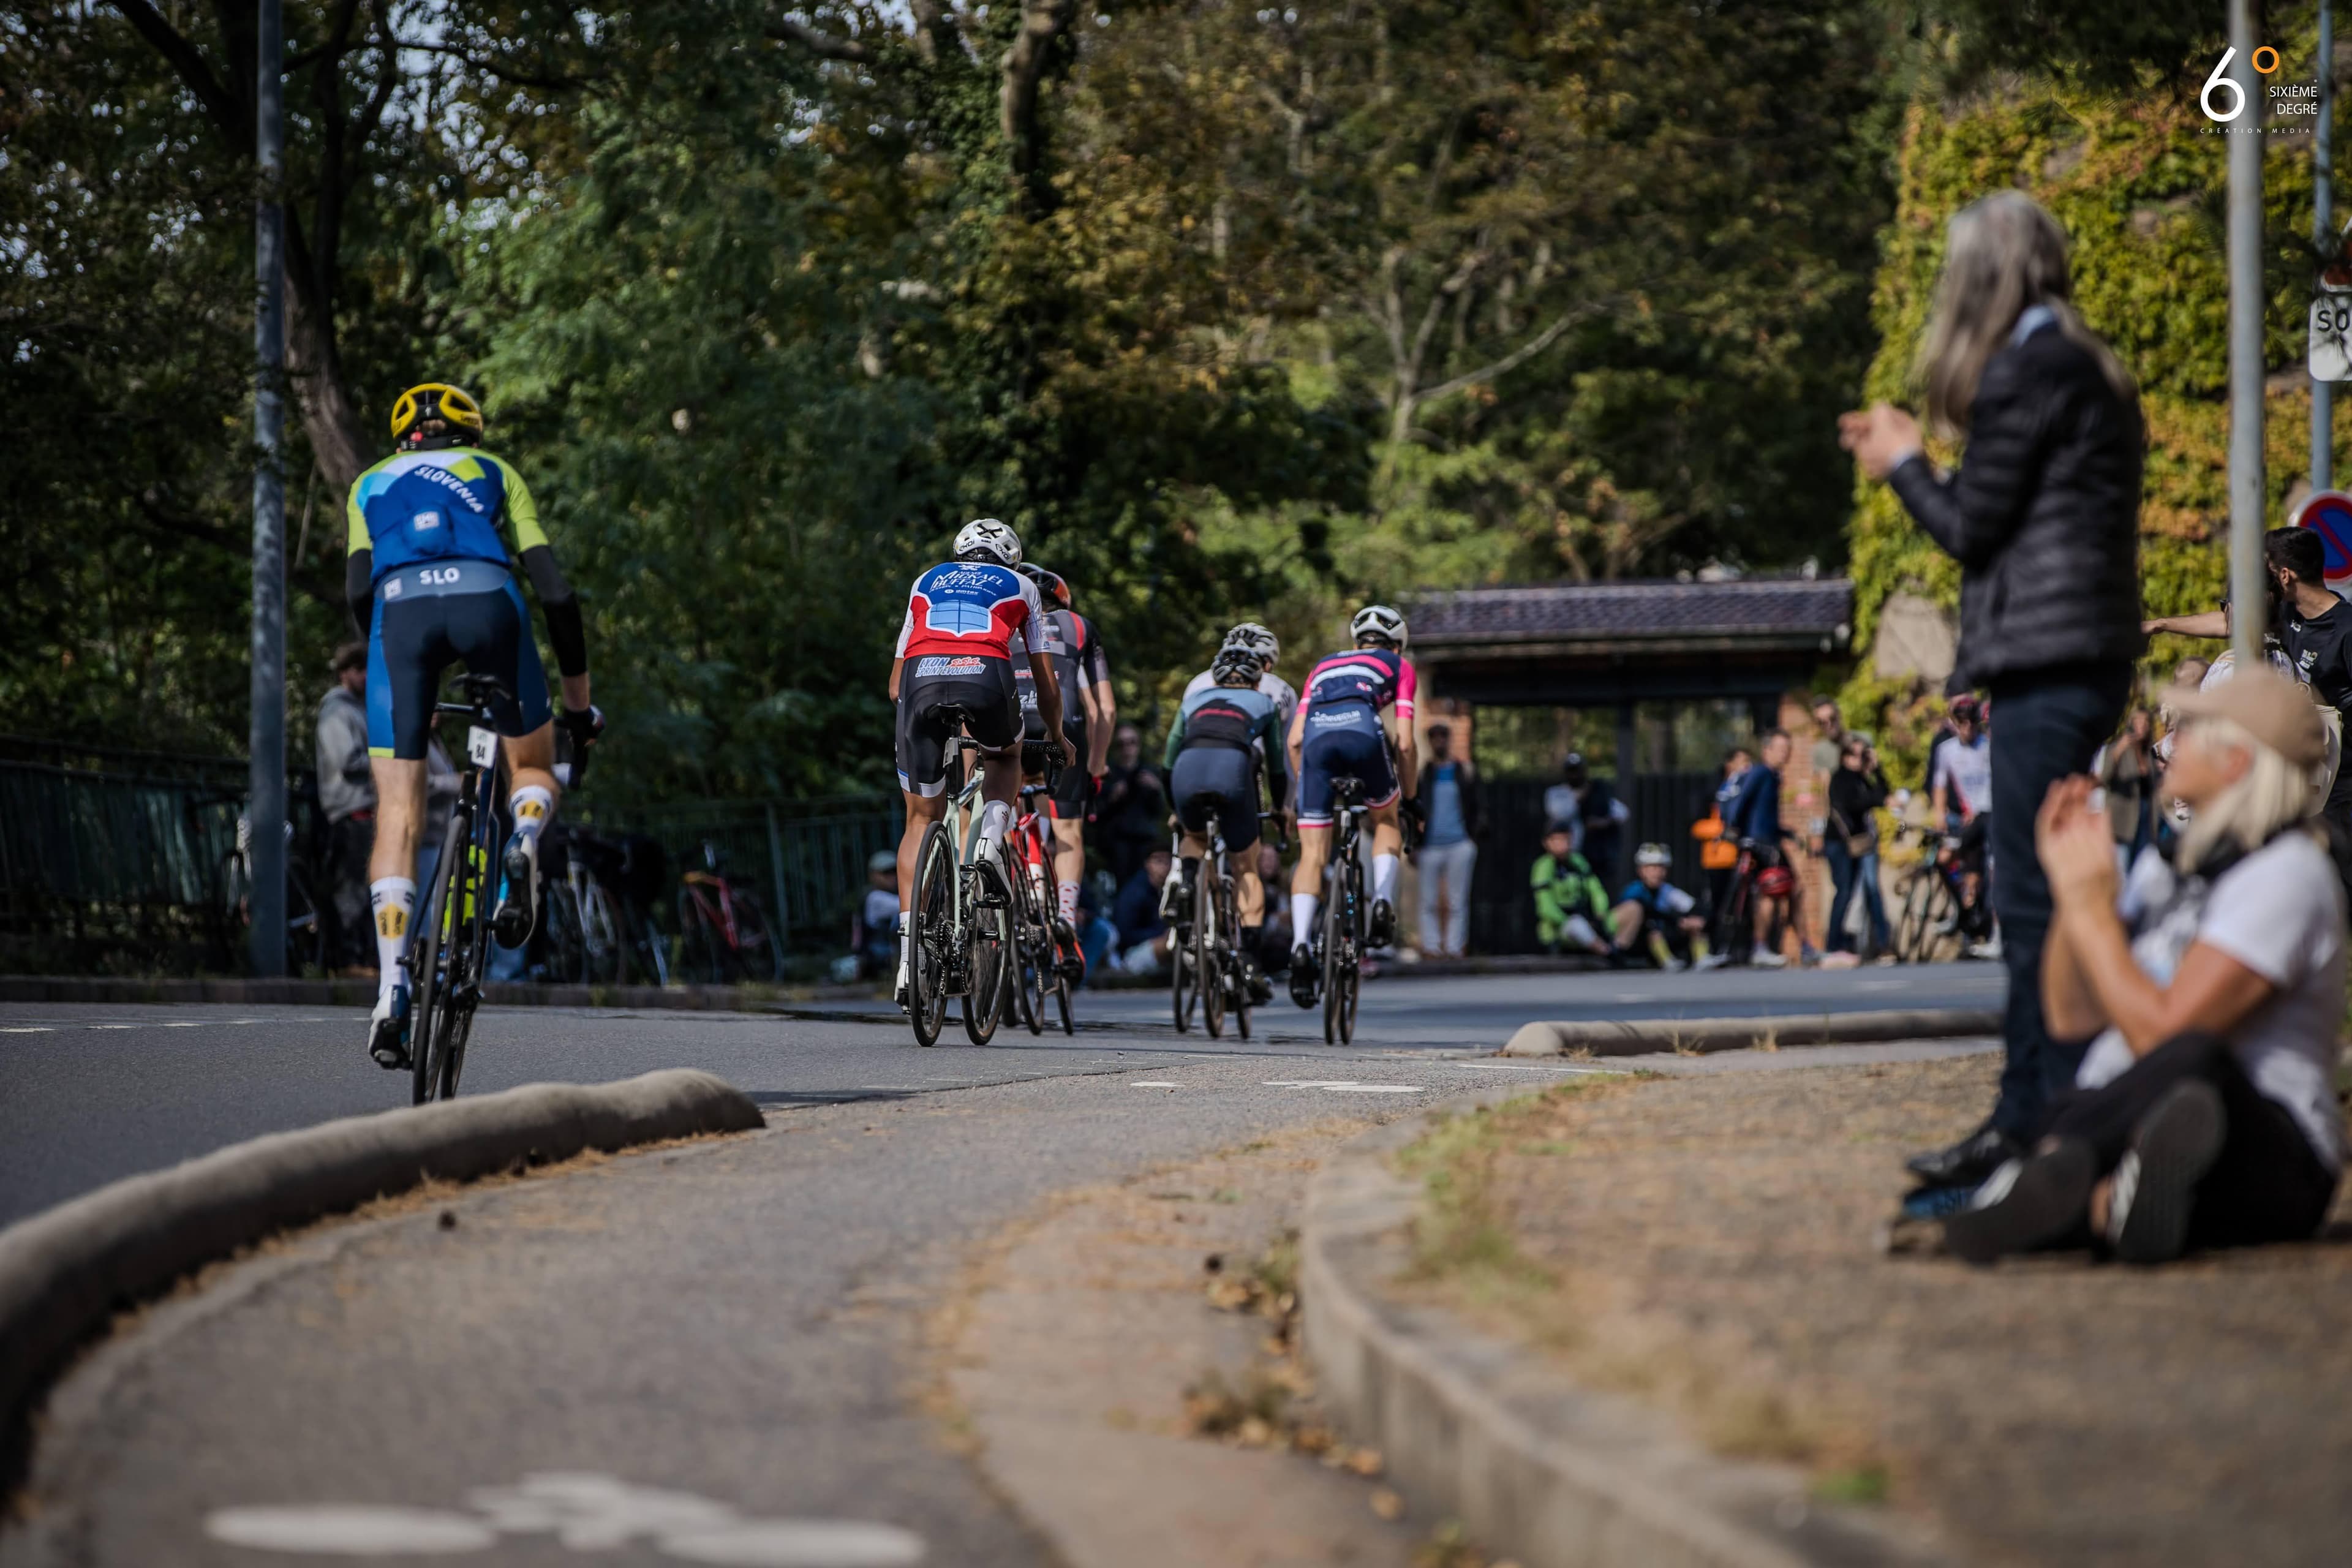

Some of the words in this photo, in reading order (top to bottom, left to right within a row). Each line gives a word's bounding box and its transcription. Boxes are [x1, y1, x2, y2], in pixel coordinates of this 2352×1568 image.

[414, 466, 484, 513] SLOVENIA
[420, 567, 461, 585] SLO
[933, 578, 987, 588] BUFFAZ
[918, 657, 950, 668] LYON
